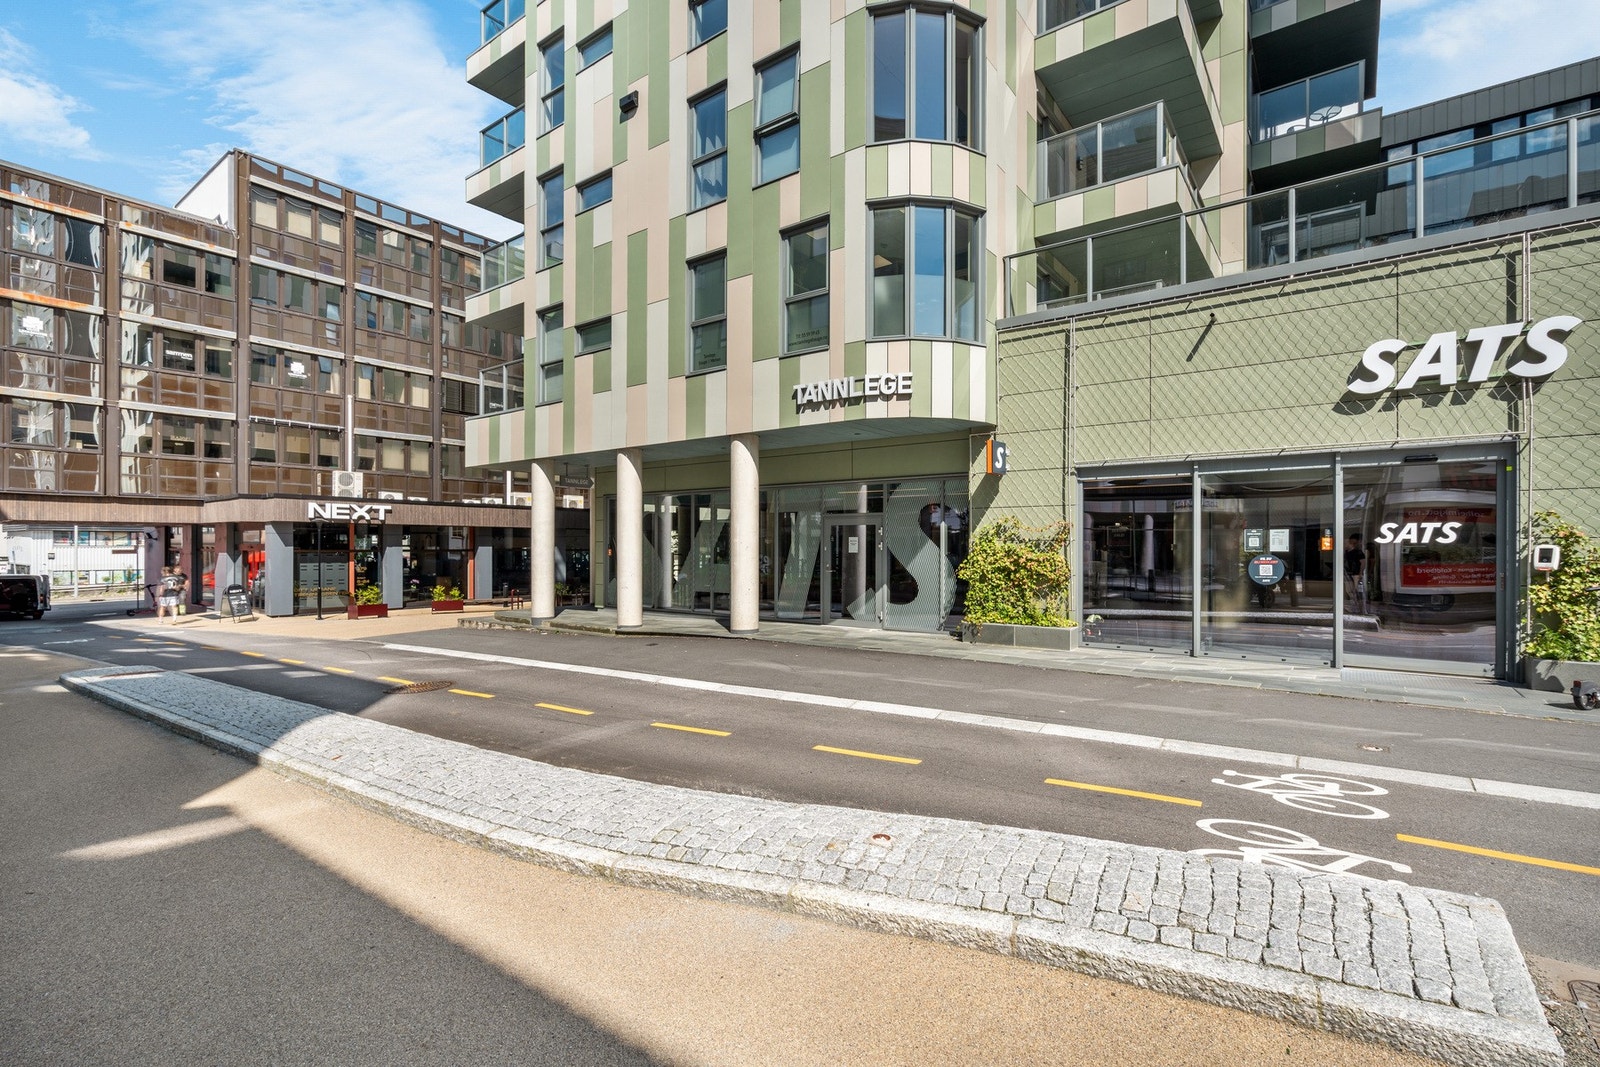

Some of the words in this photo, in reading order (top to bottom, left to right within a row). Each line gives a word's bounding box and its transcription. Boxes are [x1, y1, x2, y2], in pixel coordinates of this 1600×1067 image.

[1347, 315, 1583, 394] SATS
[793, 372, 913, 405] TANNLEGE
[994, 446, 1005, 469] S
[308, 502, 392, 521] NEXT
[1374, 521, 1463, 544] SATS
